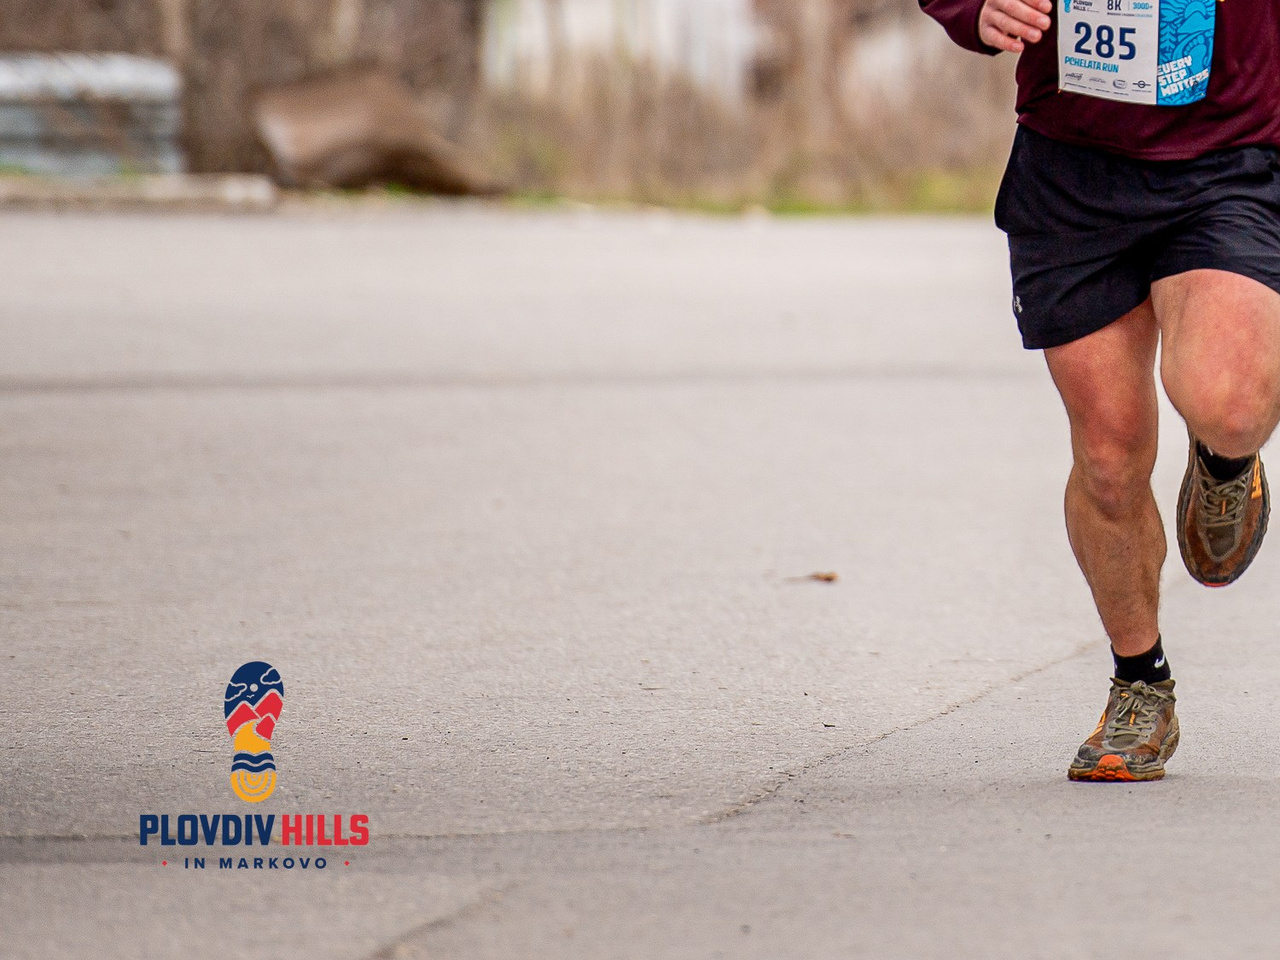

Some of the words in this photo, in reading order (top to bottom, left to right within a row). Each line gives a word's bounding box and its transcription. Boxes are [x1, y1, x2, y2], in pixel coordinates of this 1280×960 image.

[1074, 21, 1136, 60] 285
[1102, 63, 1119, 73] RUN
[1158, 68, 1187, 86] STEP
